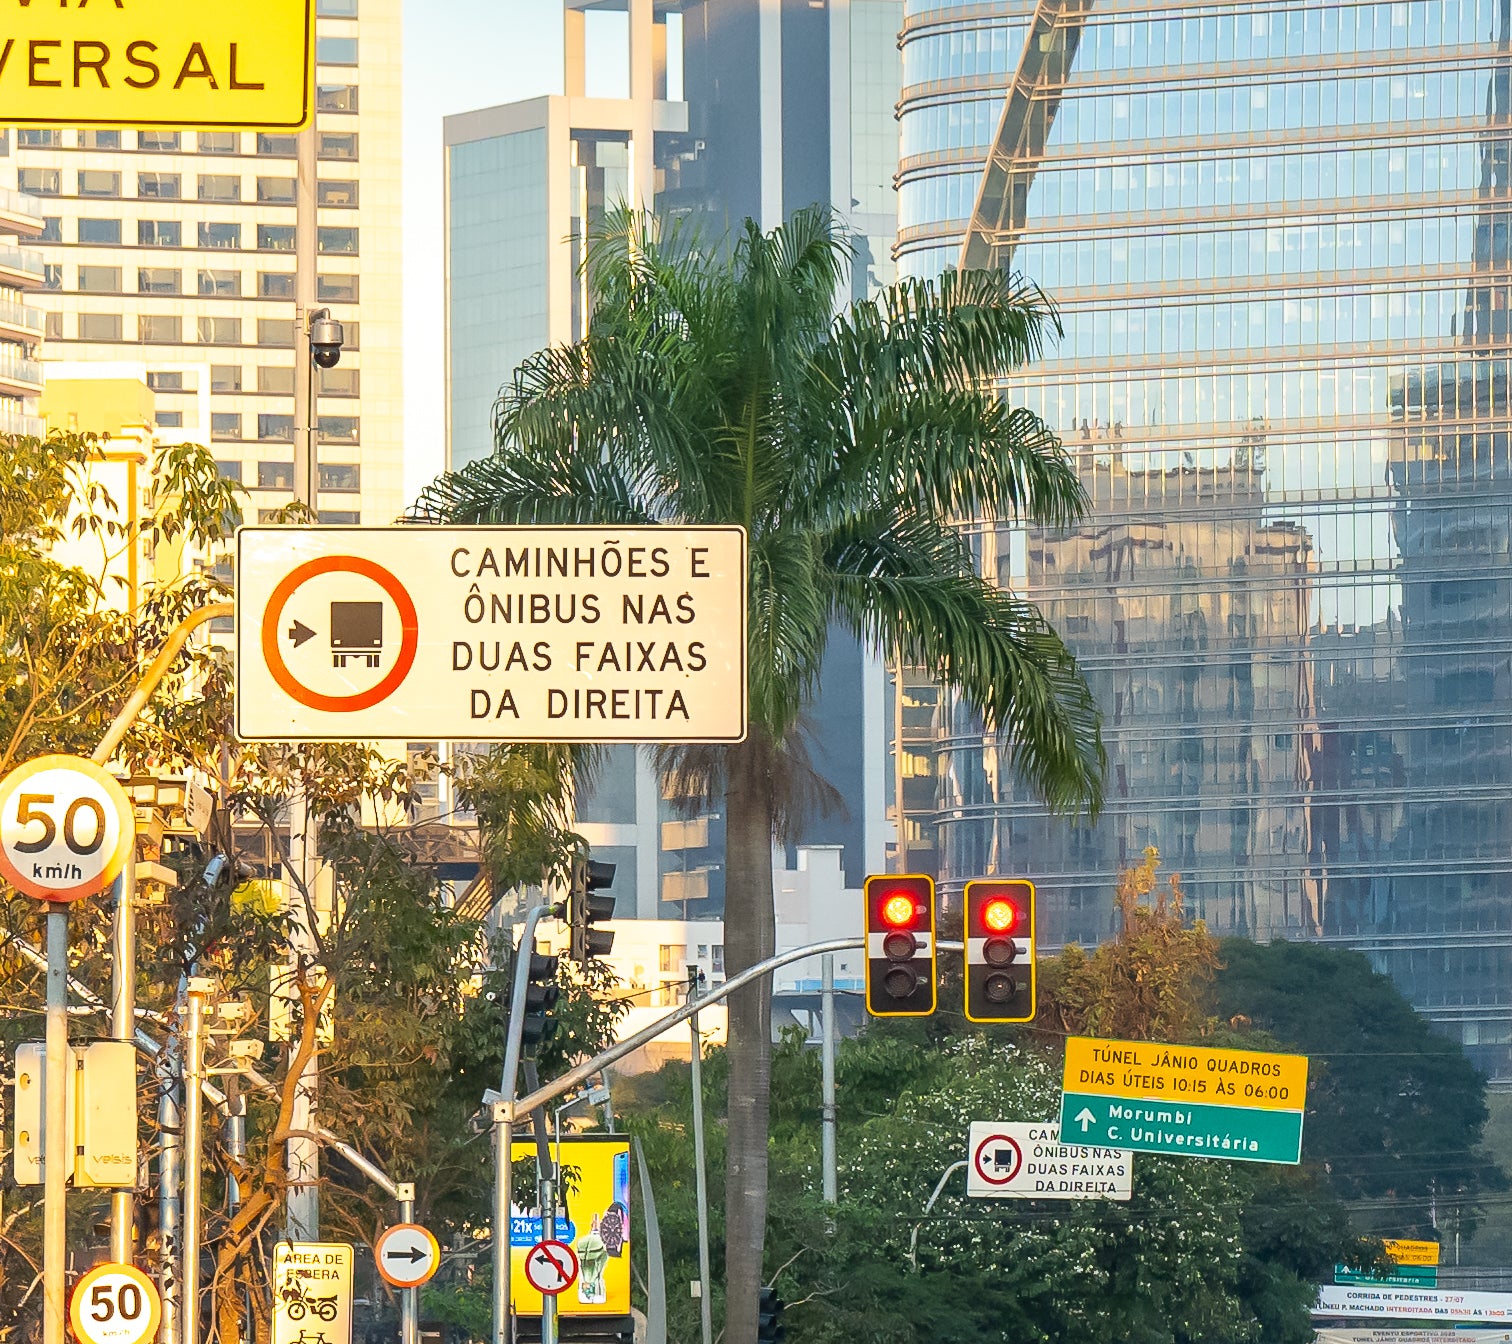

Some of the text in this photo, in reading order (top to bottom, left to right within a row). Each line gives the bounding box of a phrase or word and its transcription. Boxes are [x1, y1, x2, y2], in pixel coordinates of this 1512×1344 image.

[450, 540, 710, 578] CAMINHÕES E
[463, 584, 697, 625] ÔNIBUS NAS
[452, 641, 708, 672] DUAS FAIXAS
[471, 689, 691, 721] DA DIREITA
[12, 793, 106, 856] 50
[32, 862, 83, 882] km/h
[1092, 1043, 1281, 1077] TÚNEL JÂNIO QUADROS
[1080, 1068, 1290, 1101] DIAS ÚTEIS 10:15 ÀS 06:00
[1109, 1105, 1191, 1126] Morumbi
[1033, 1143, 1122, 1160] ÔNIBUS NAS
[1107, 1126, 1260, 1153] C. Universitária
[1027, 1162, 1125, 1177] DUAS FAIXAS
[1035, 1179, 1117, 1193] DA DIREITA
[325, 1254, 344, 1265] DE
[89, 1283, 143, 1324] 50
[1347, 1292, 1381, 1300] CORRIDA
[1395, 1294, 1438, 1302] PEDESTRES
[1349, 1304, 1384, 1312] MACHADO
